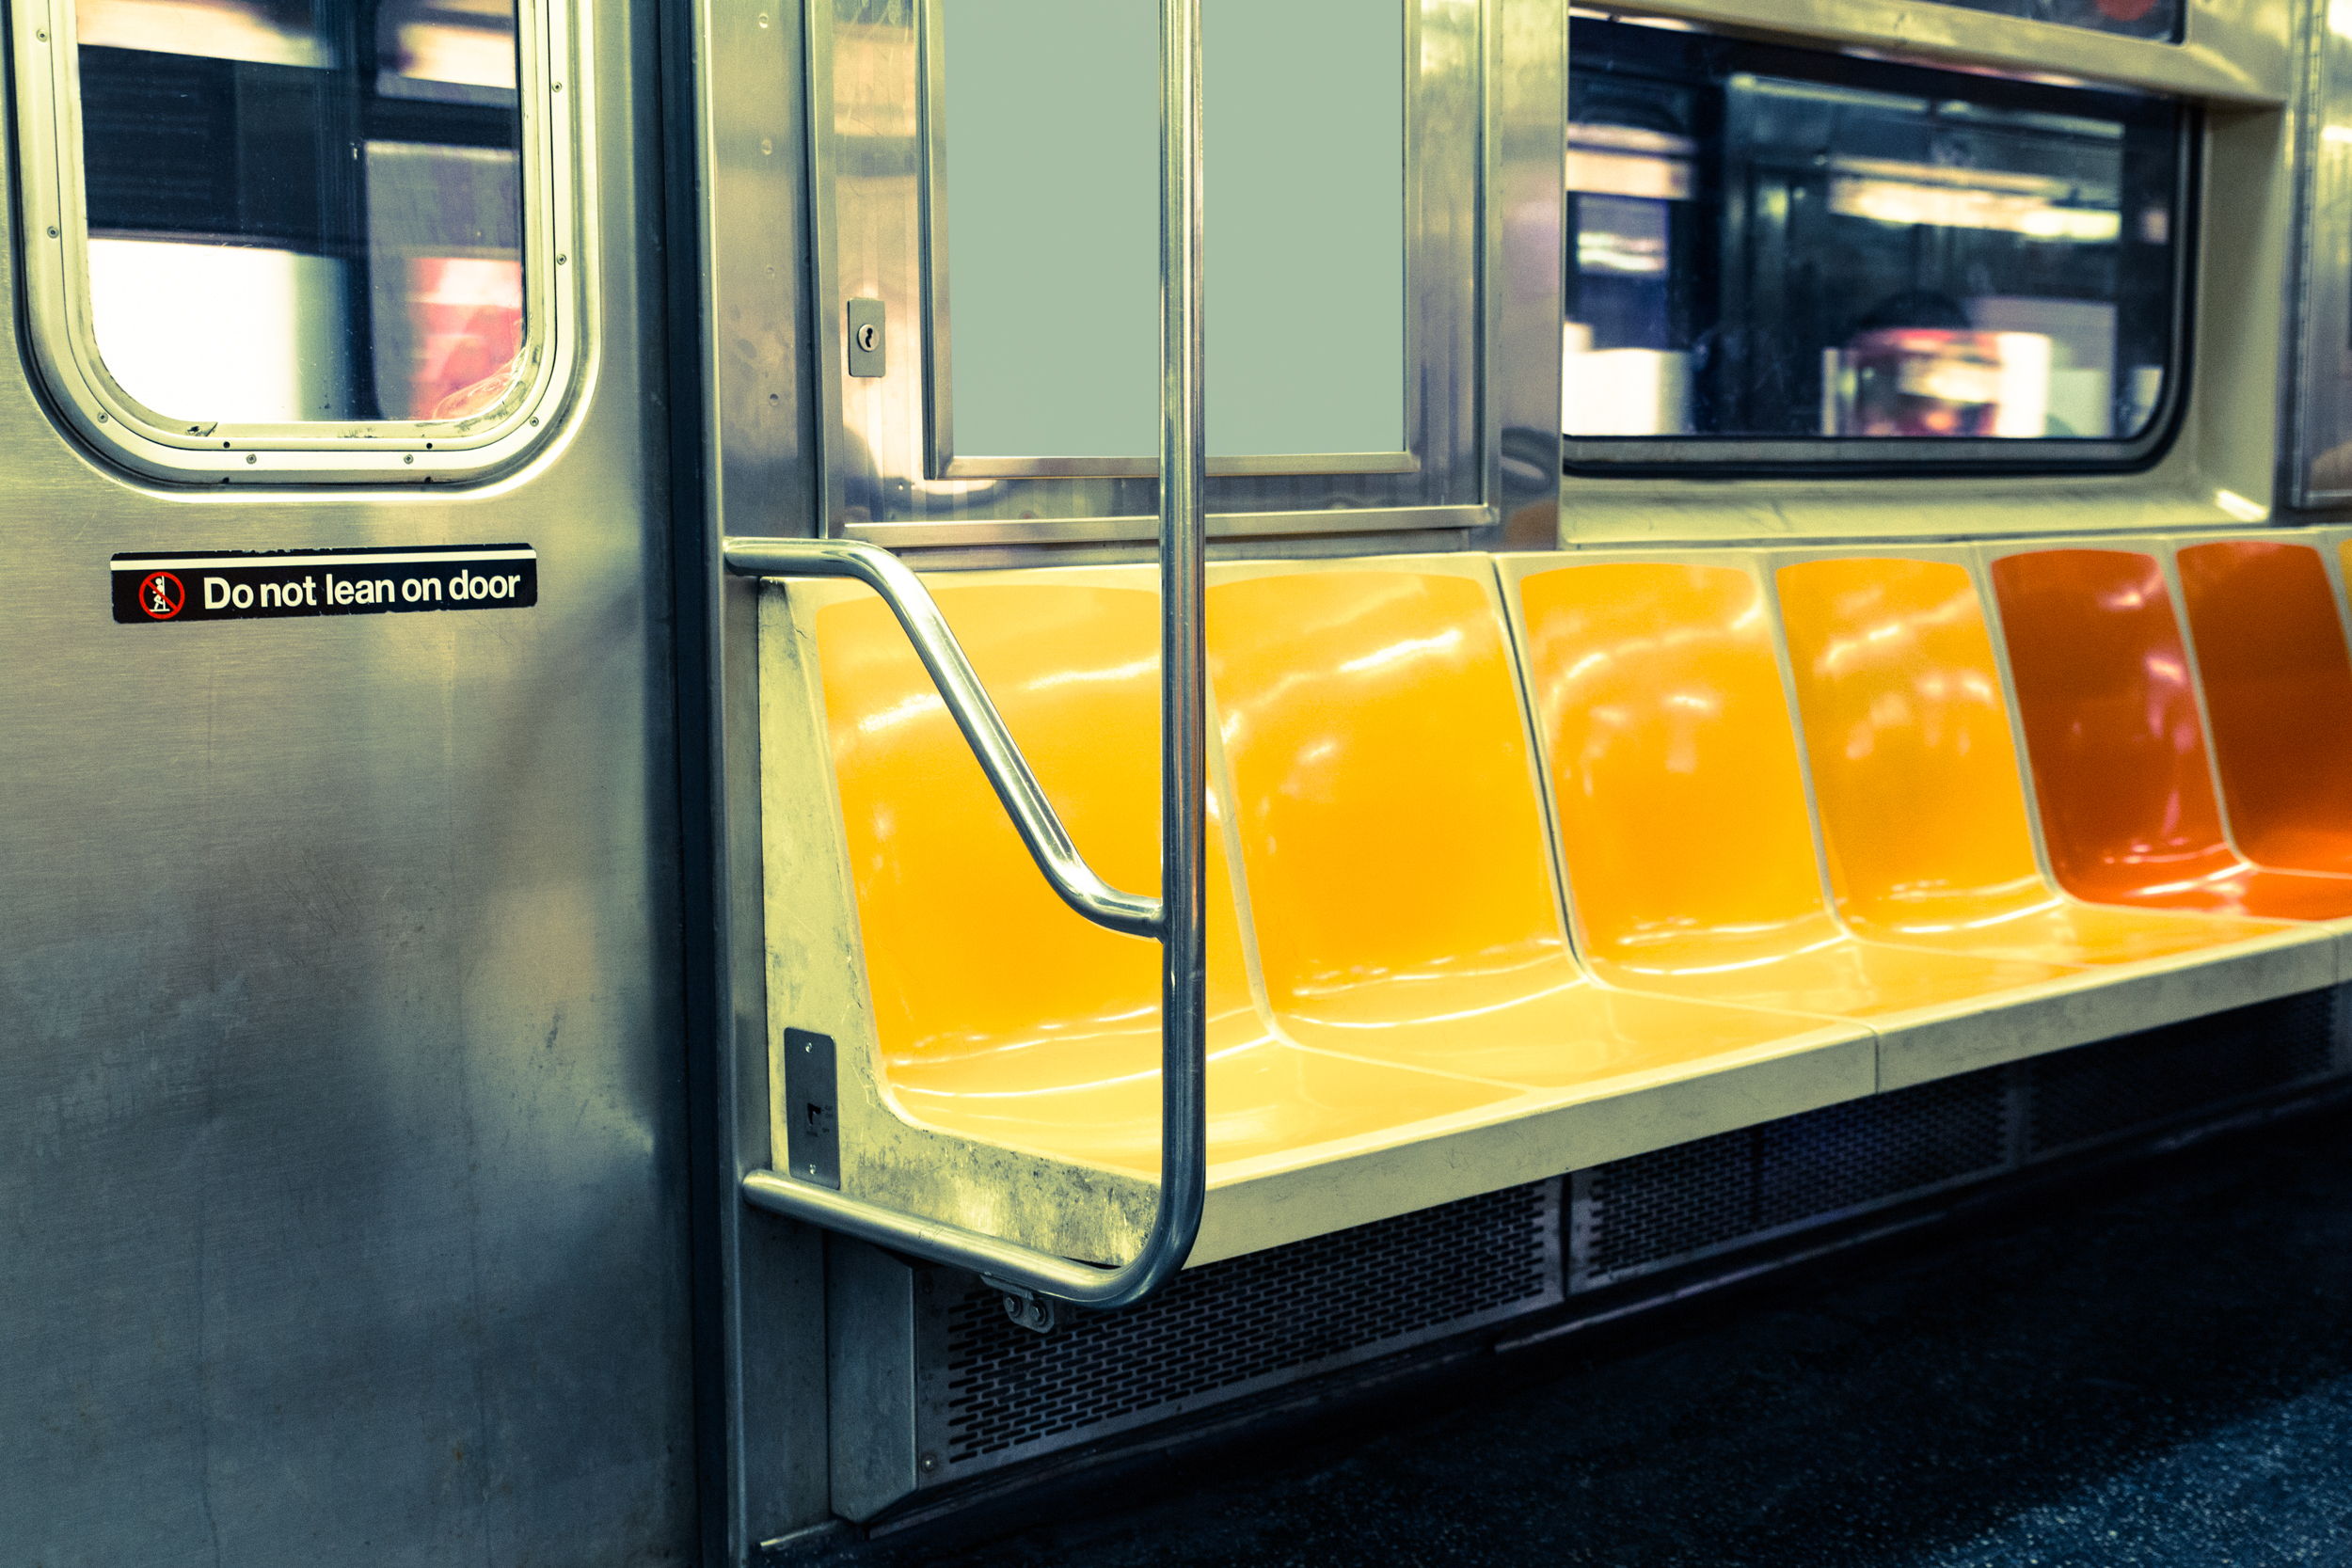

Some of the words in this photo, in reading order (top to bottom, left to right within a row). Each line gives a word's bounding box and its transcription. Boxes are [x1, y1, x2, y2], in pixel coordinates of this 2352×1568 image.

[203, 577, 254, 610] Do
[260, 576, 317, 608] not
[326, 573, 396, 606] lean
[401, 578, 442, 602] on
[448, 569, 521, 601] door
